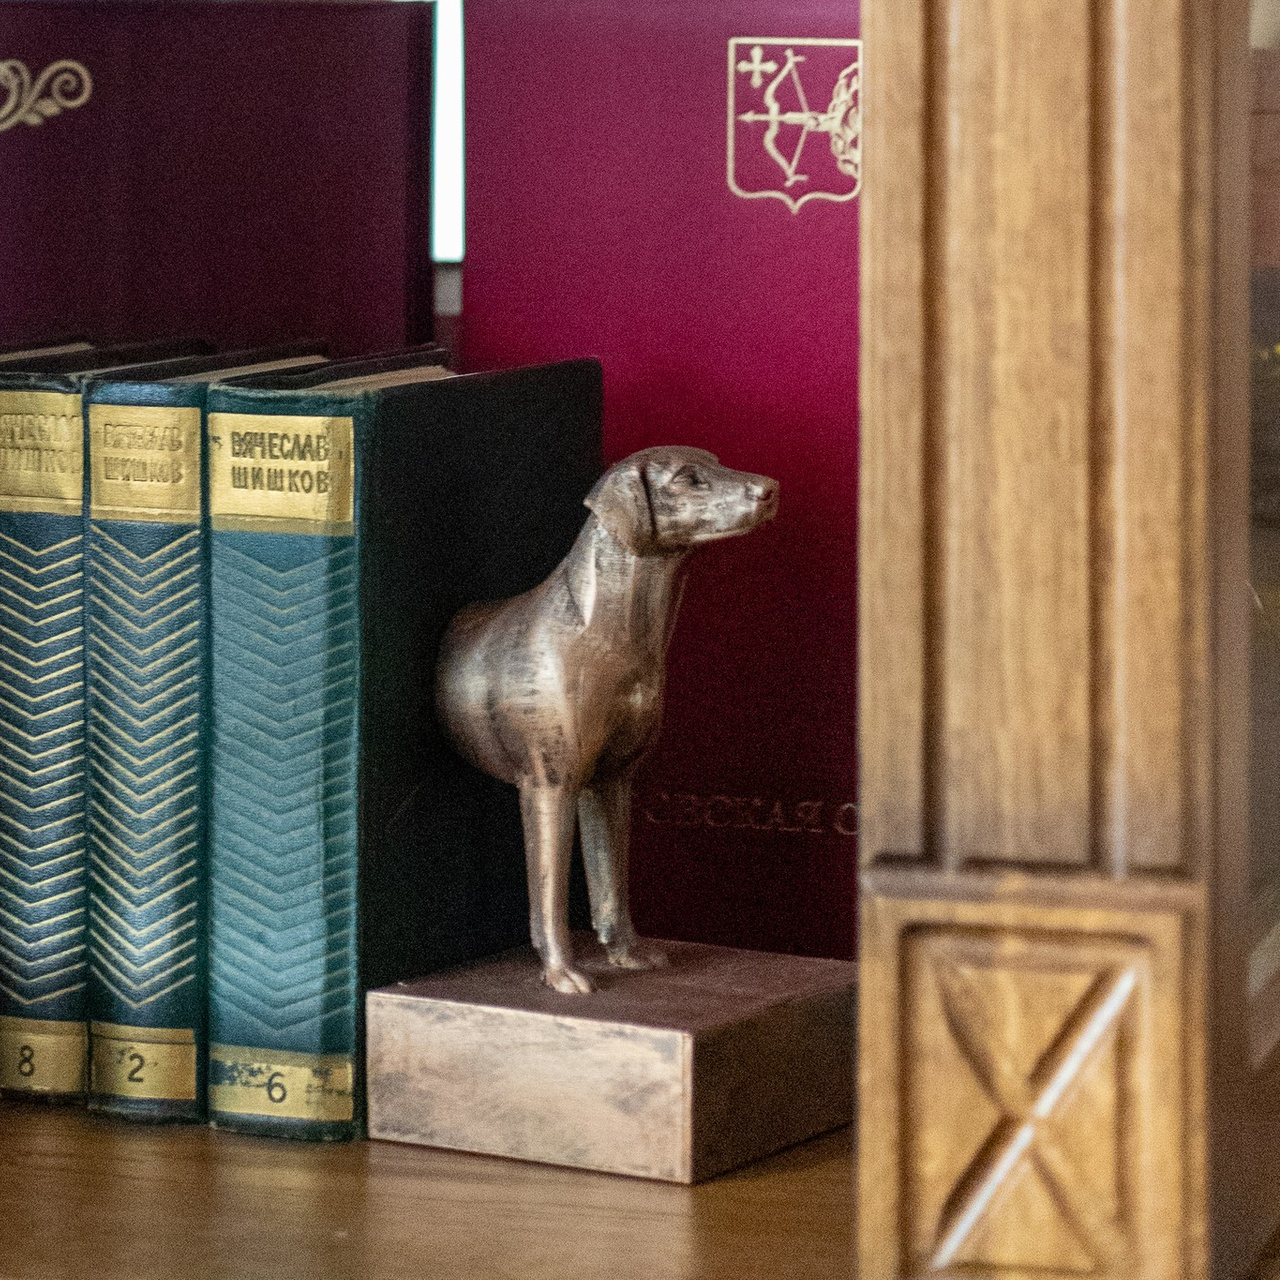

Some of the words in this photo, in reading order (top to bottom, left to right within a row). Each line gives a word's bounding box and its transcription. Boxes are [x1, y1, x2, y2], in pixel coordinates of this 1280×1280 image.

[230, 430, 329, 462] ВЯЧЕСЛАВ
[231, 464, 329, 494] ШИШКОВ
[19, 1044, 35, 1078] 8
[126, 1052, 146, 1084] 2
[265, 1071, 288, 1104] 6
